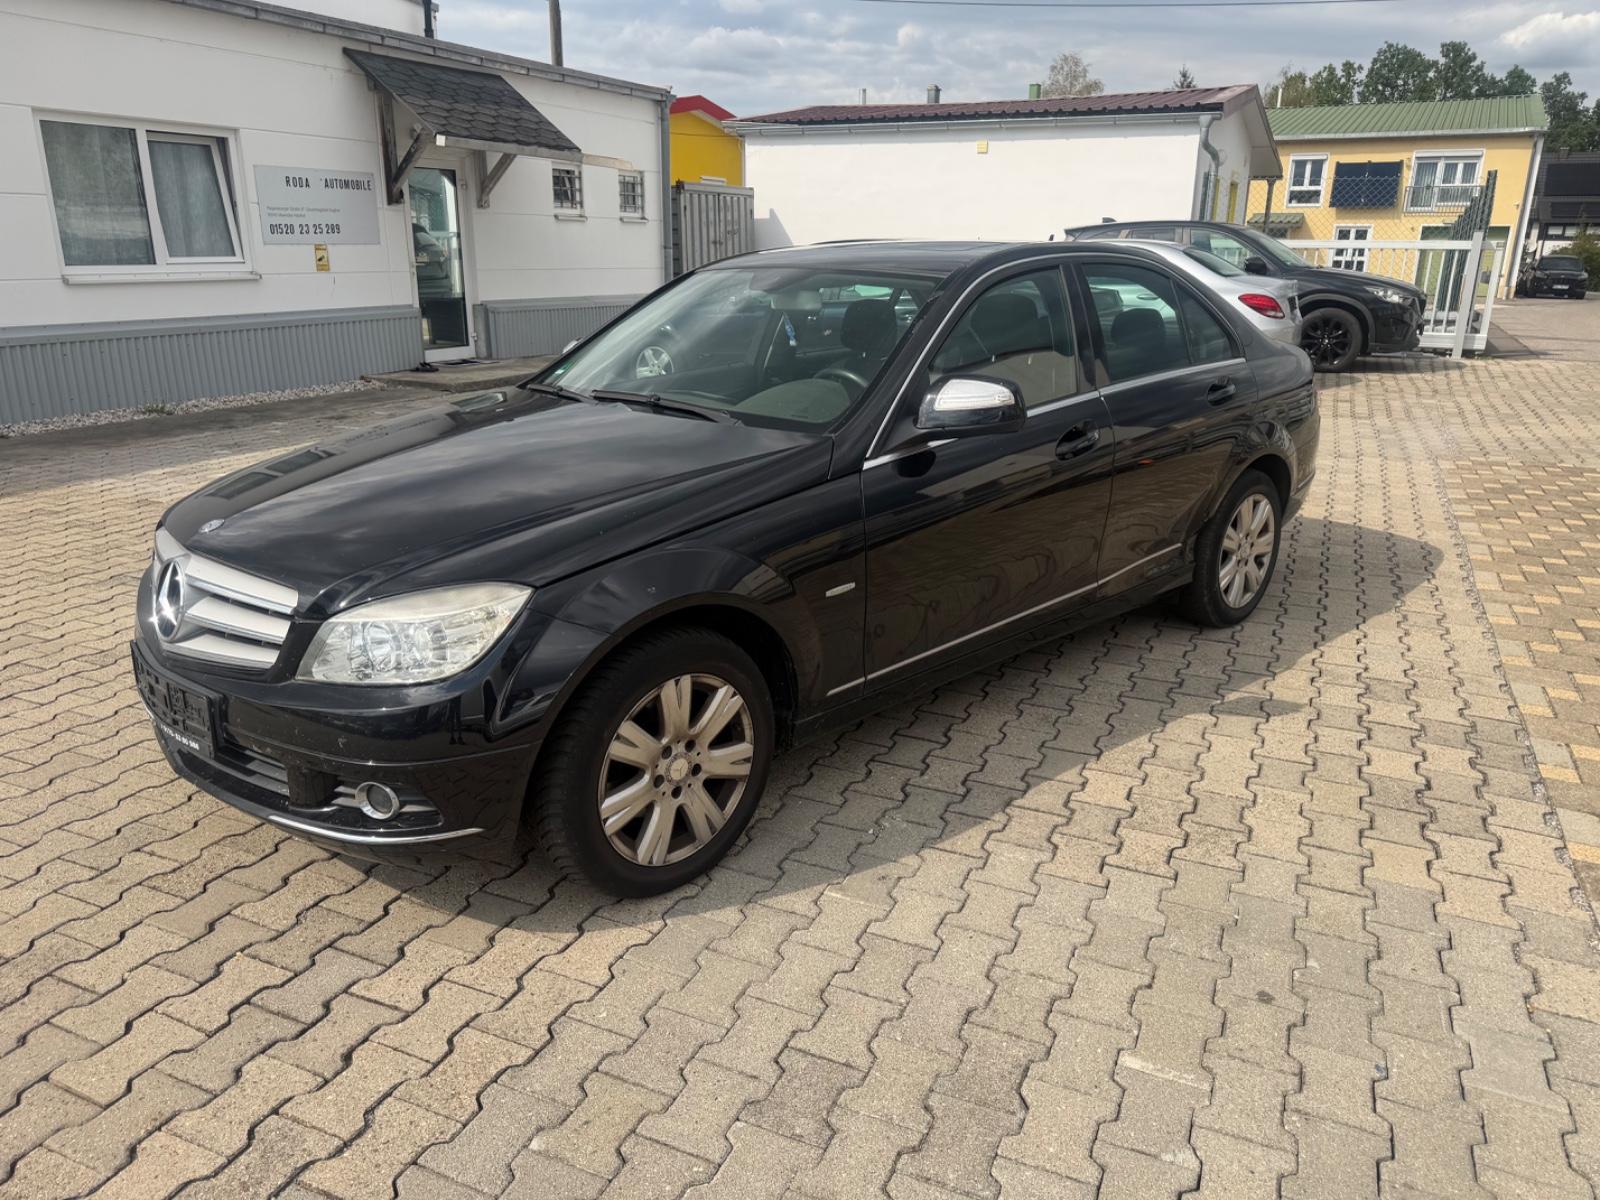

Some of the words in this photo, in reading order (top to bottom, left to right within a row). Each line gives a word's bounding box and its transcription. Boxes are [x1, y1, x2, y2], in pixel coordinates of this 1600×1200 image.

[285, 175, 310, 188] RODA
[324, 177, 372, 191] AUTOMOBILE
[269, 223, 295, 235] 01520
[298, 223, 310, 235] 23
[312, 223, 324, 235] 25
